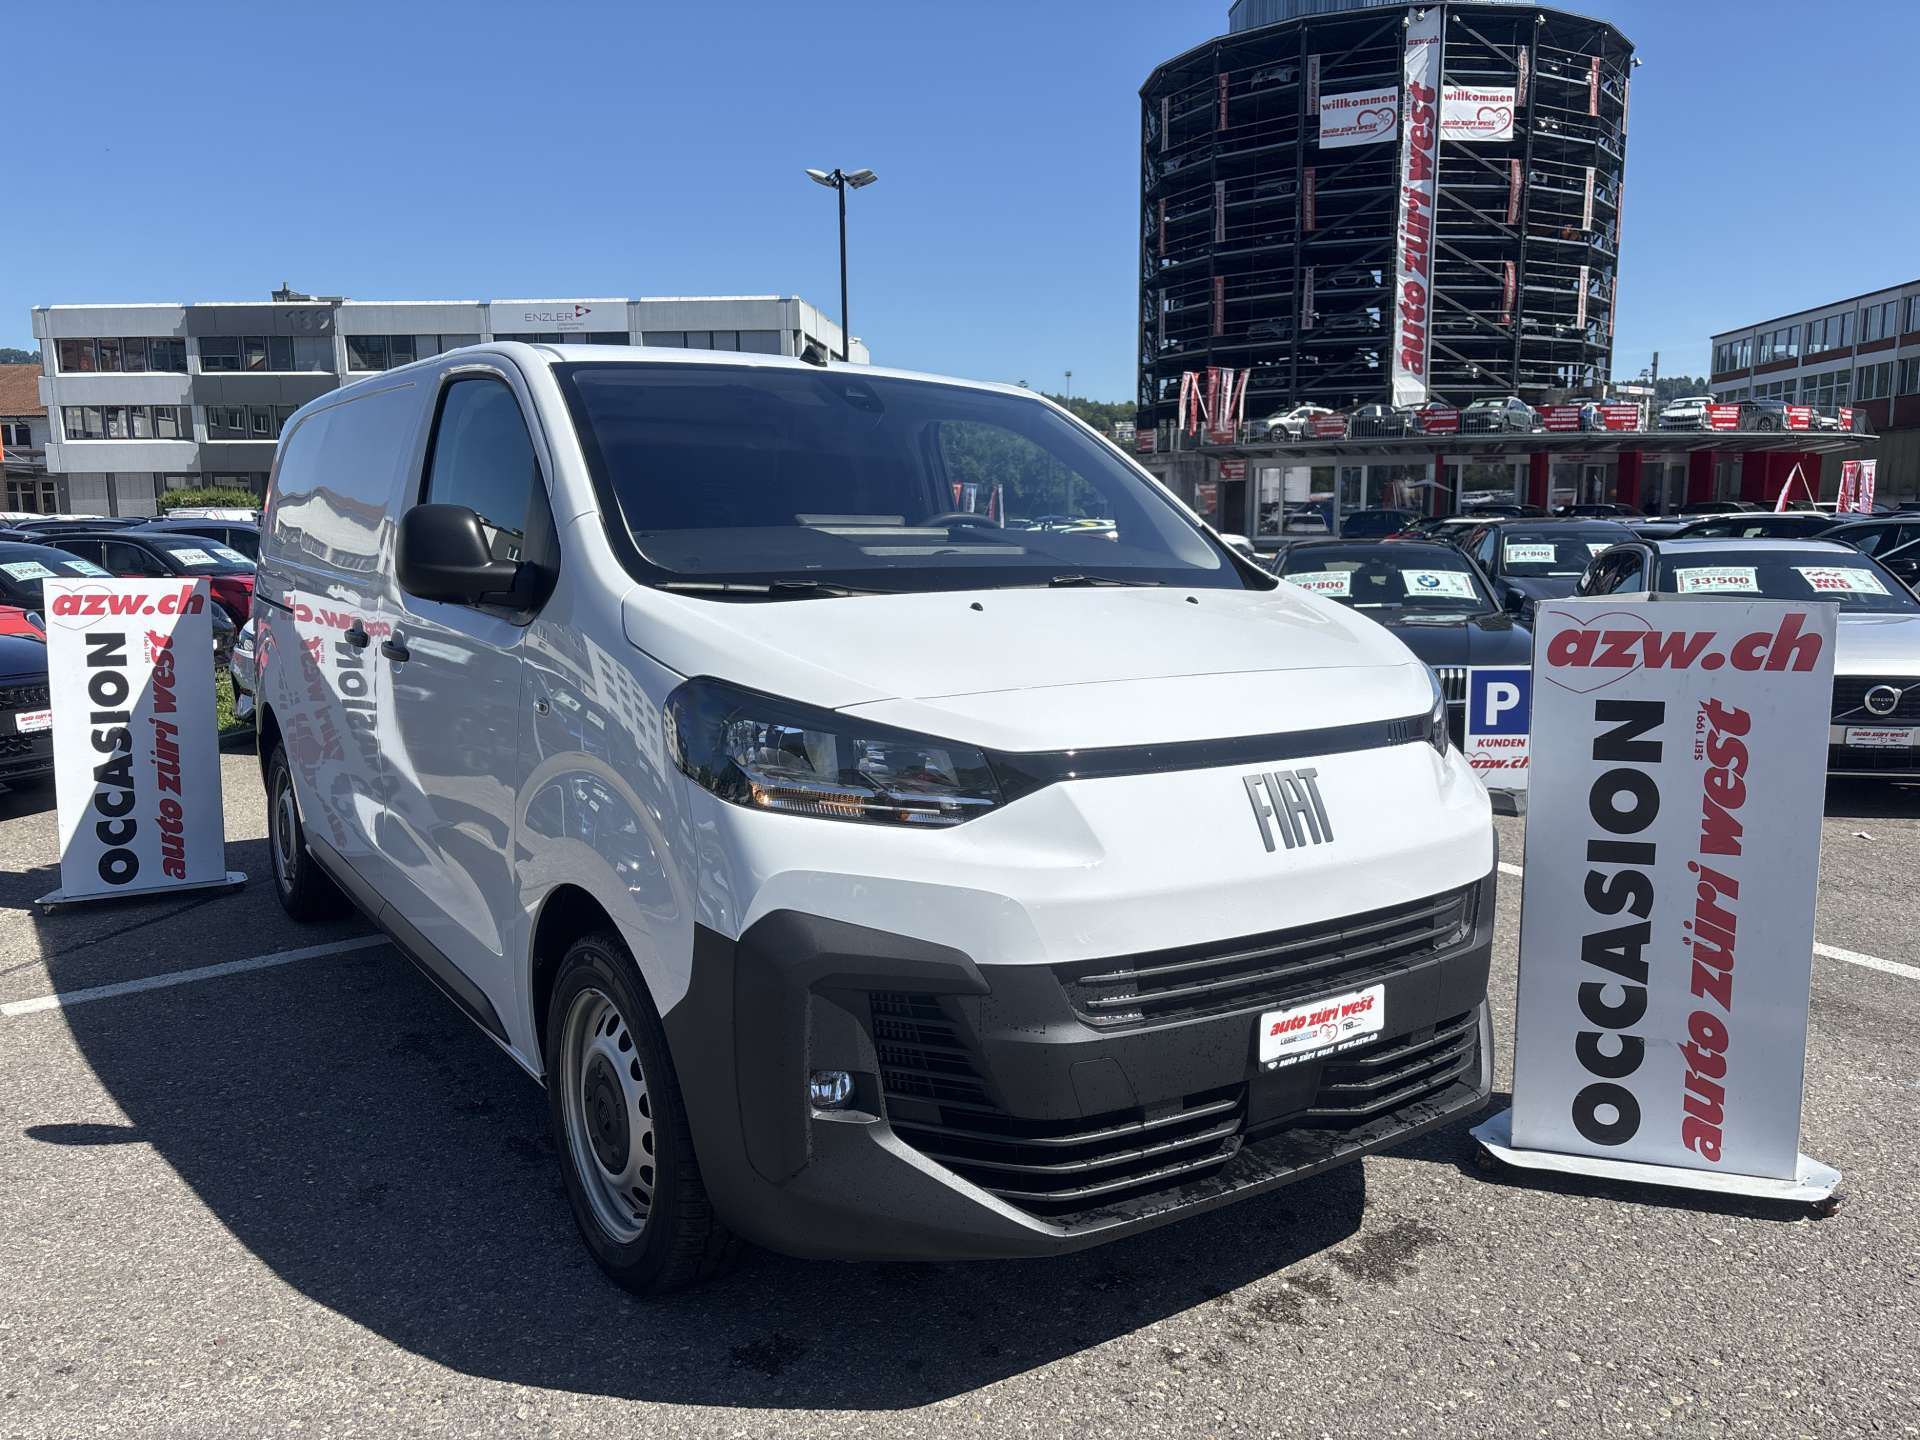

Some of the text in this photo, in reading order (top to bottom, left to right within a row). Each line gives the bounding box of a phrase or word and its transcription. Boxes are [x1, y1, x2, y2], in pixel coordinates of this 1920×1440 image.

[1408, 35, 1439, 45] azw.ch
[1322, 94, 1396, 111] willkommen
[1444, 88, 1513, 102] willkommen
[1399, 80, 1435, 375] auto züri west
[525, 312, 573, 322] ENZLER
[52, 584, 204, 616] azw.ch
[1298, 581, 1344, 590] 6'800
[1690, 576, 1750, 585] 33'500
[1547, 613, 1823, 672] azw.ch
[1485, 682, 1520, 726] P
[145, 629, 186, 880] auto züri west
[1477, 738, 1526, 748] KUNDEN
[1694, 710, 1707, 761] SEIT 1991
[85, 632, 139, 885] OCCASION
[1243, 768, 1334, 853] FIAT
[1571, 699, 1665, 1146] OCCASION
[1677, 697, 1751, 1162] auto züri west
[1270, 995, 1375, 1036] auto züri west
